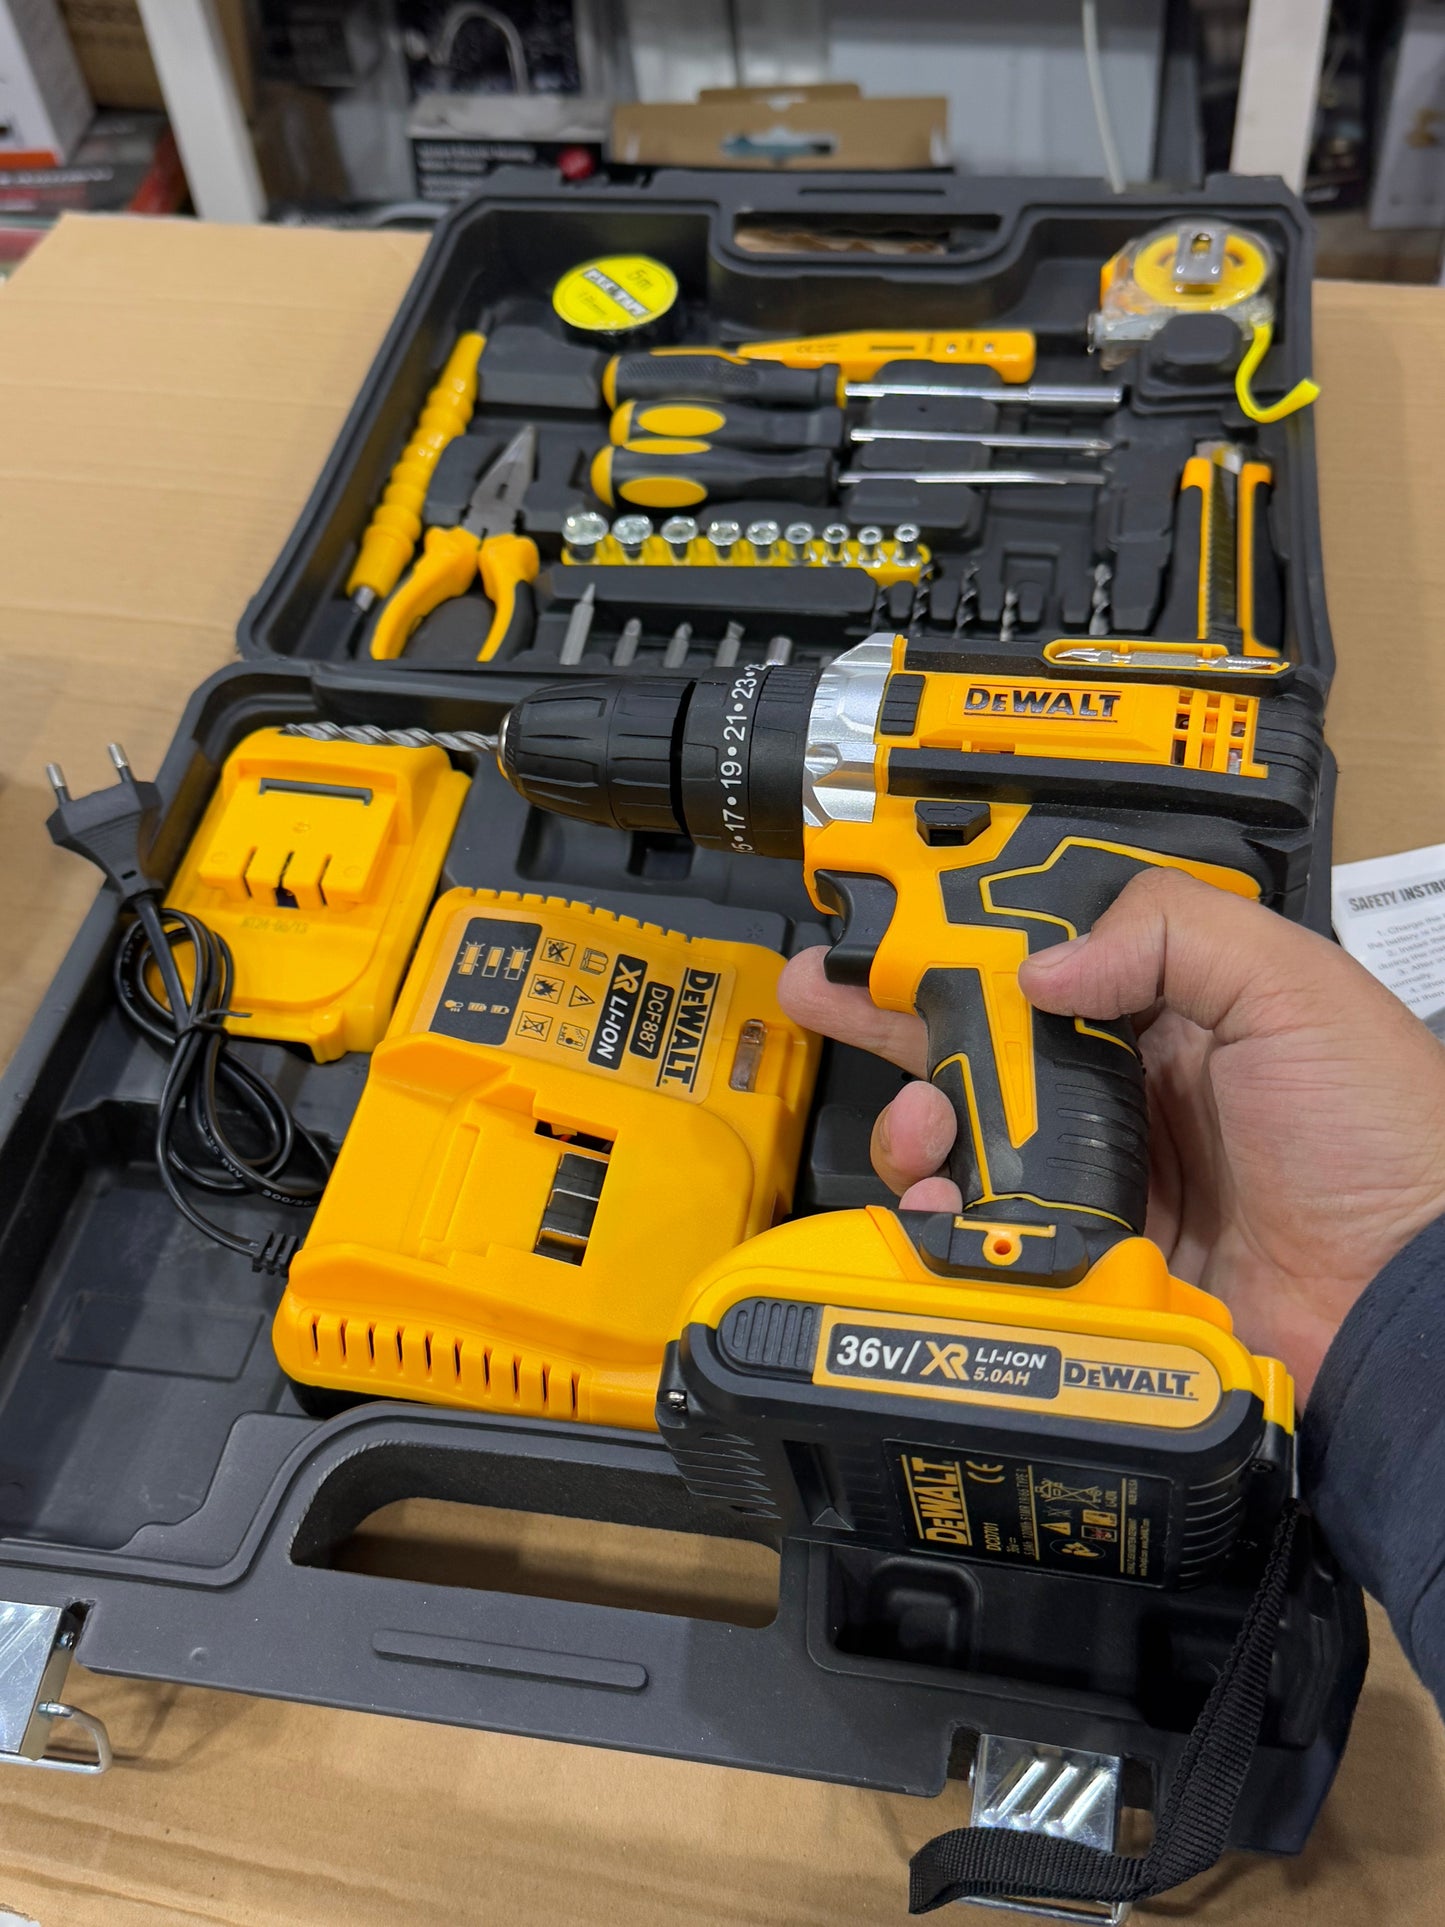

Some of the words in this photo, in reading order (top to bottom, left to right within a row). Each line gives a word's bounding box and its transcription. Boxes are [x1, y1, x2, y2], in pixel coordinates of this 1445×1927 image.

[731, 678, 757, 699] 23
[723, 715, 747, 741] 21
[720, 761, 742, 789] 19
[722, 809, 747, 831] 17
[1348, 890, 1398, 912] SAFETY
[611, 961, 642, 995] XR
[596, 994, 629, 1060] LI-ION
[636, 986, 669, 1054] DCF887
[920, 1340, 971, 1381] XR
[974, 1346, 1047, 1371] LI-ION
[973, 1366, 1030, 1387] 5.0AH
[981, 1522, 1002, 1552] DCD701
